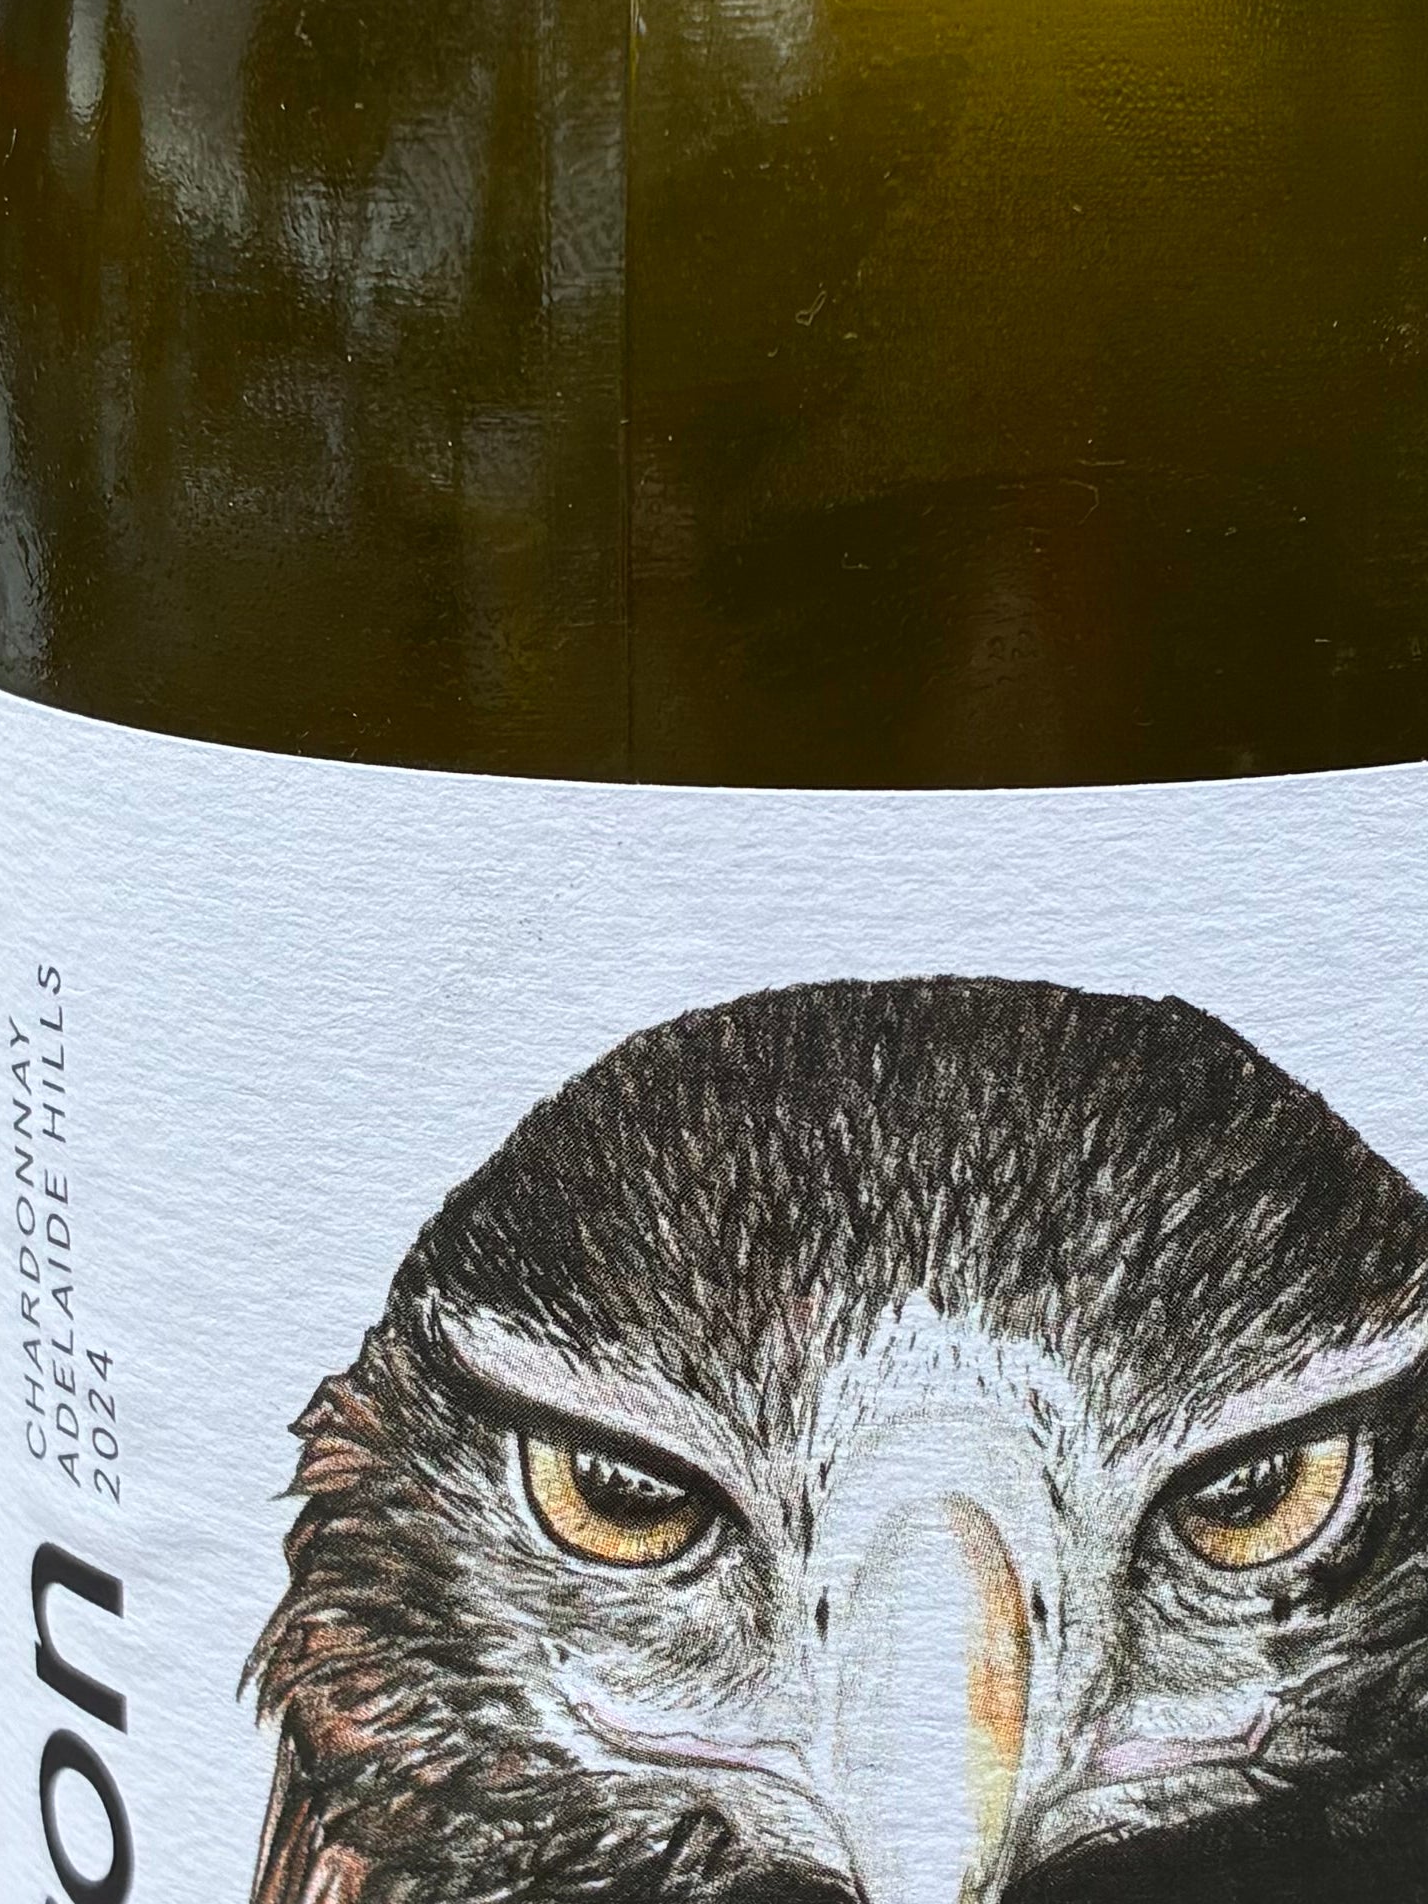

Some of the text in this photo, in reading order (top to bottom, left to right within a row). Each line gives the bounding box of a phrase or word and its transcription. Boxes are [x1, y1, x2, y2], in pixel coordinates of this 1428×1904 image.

[9, 1014, 48, 1460] CHARDONNAY
[37, 963, 81, 1488] ADELAIDE HILLS
[86, 1349, 120, 1505] 2024
